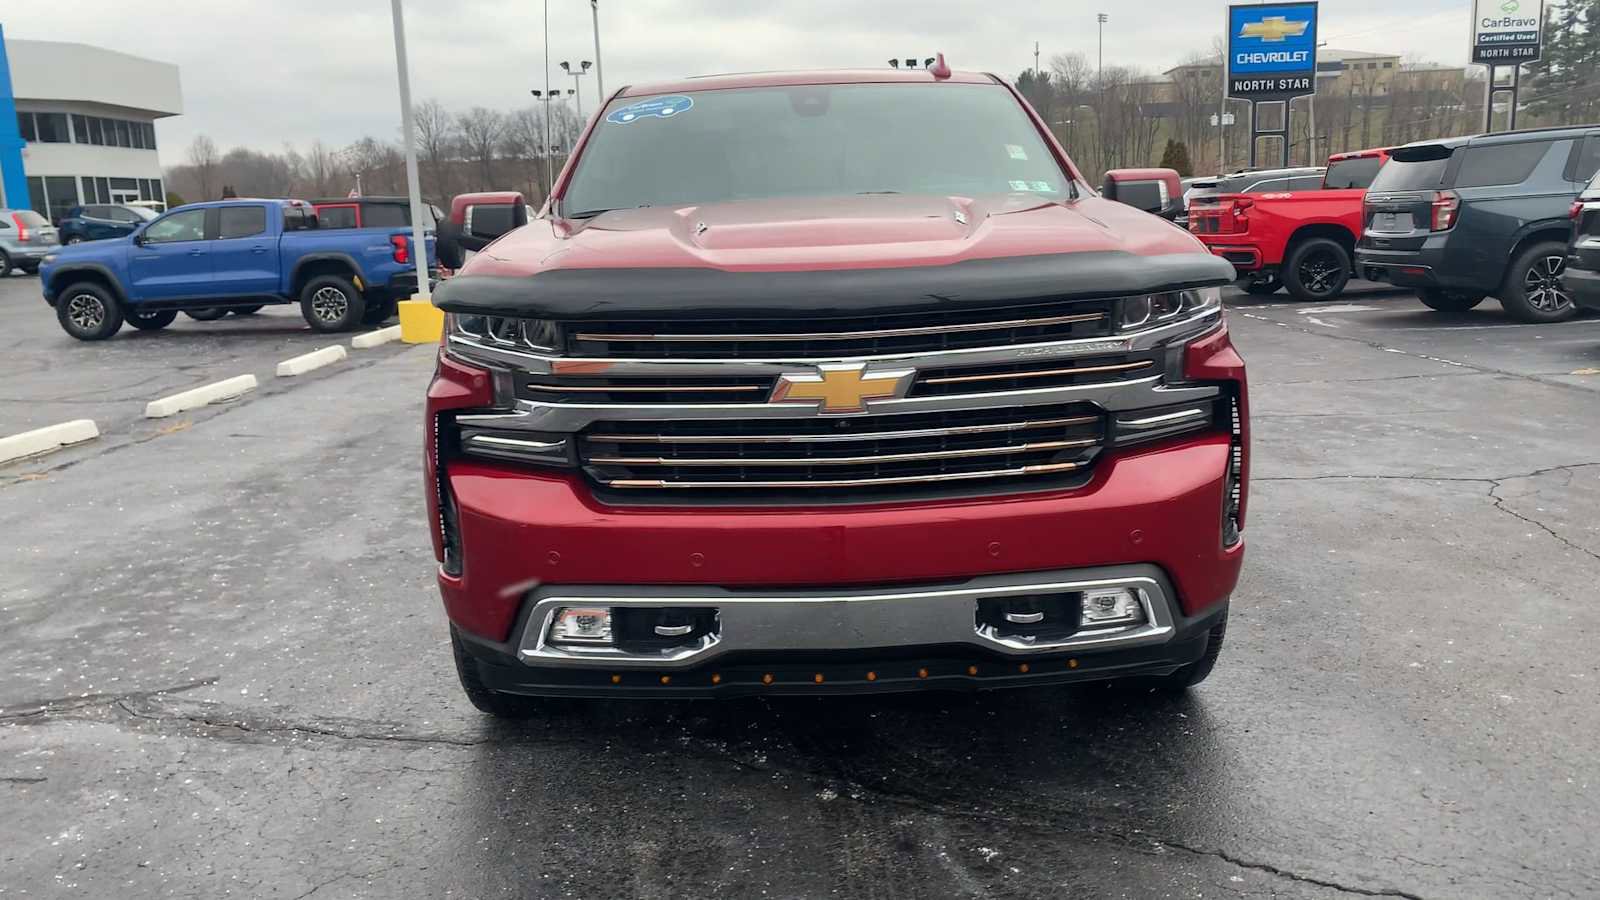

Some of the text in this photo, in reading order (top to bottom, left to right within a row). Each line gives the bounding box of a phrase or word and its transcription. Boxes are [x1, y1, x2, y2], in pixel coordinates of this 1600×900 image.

[1481, 17, 1536, 28] CarBravo
[1236, 51, 1309, 64] CHEVROLET
[1480, 47, 1534, 57] NORTH STAR
[1234, 78, 1309, 91] NORTH STAR
